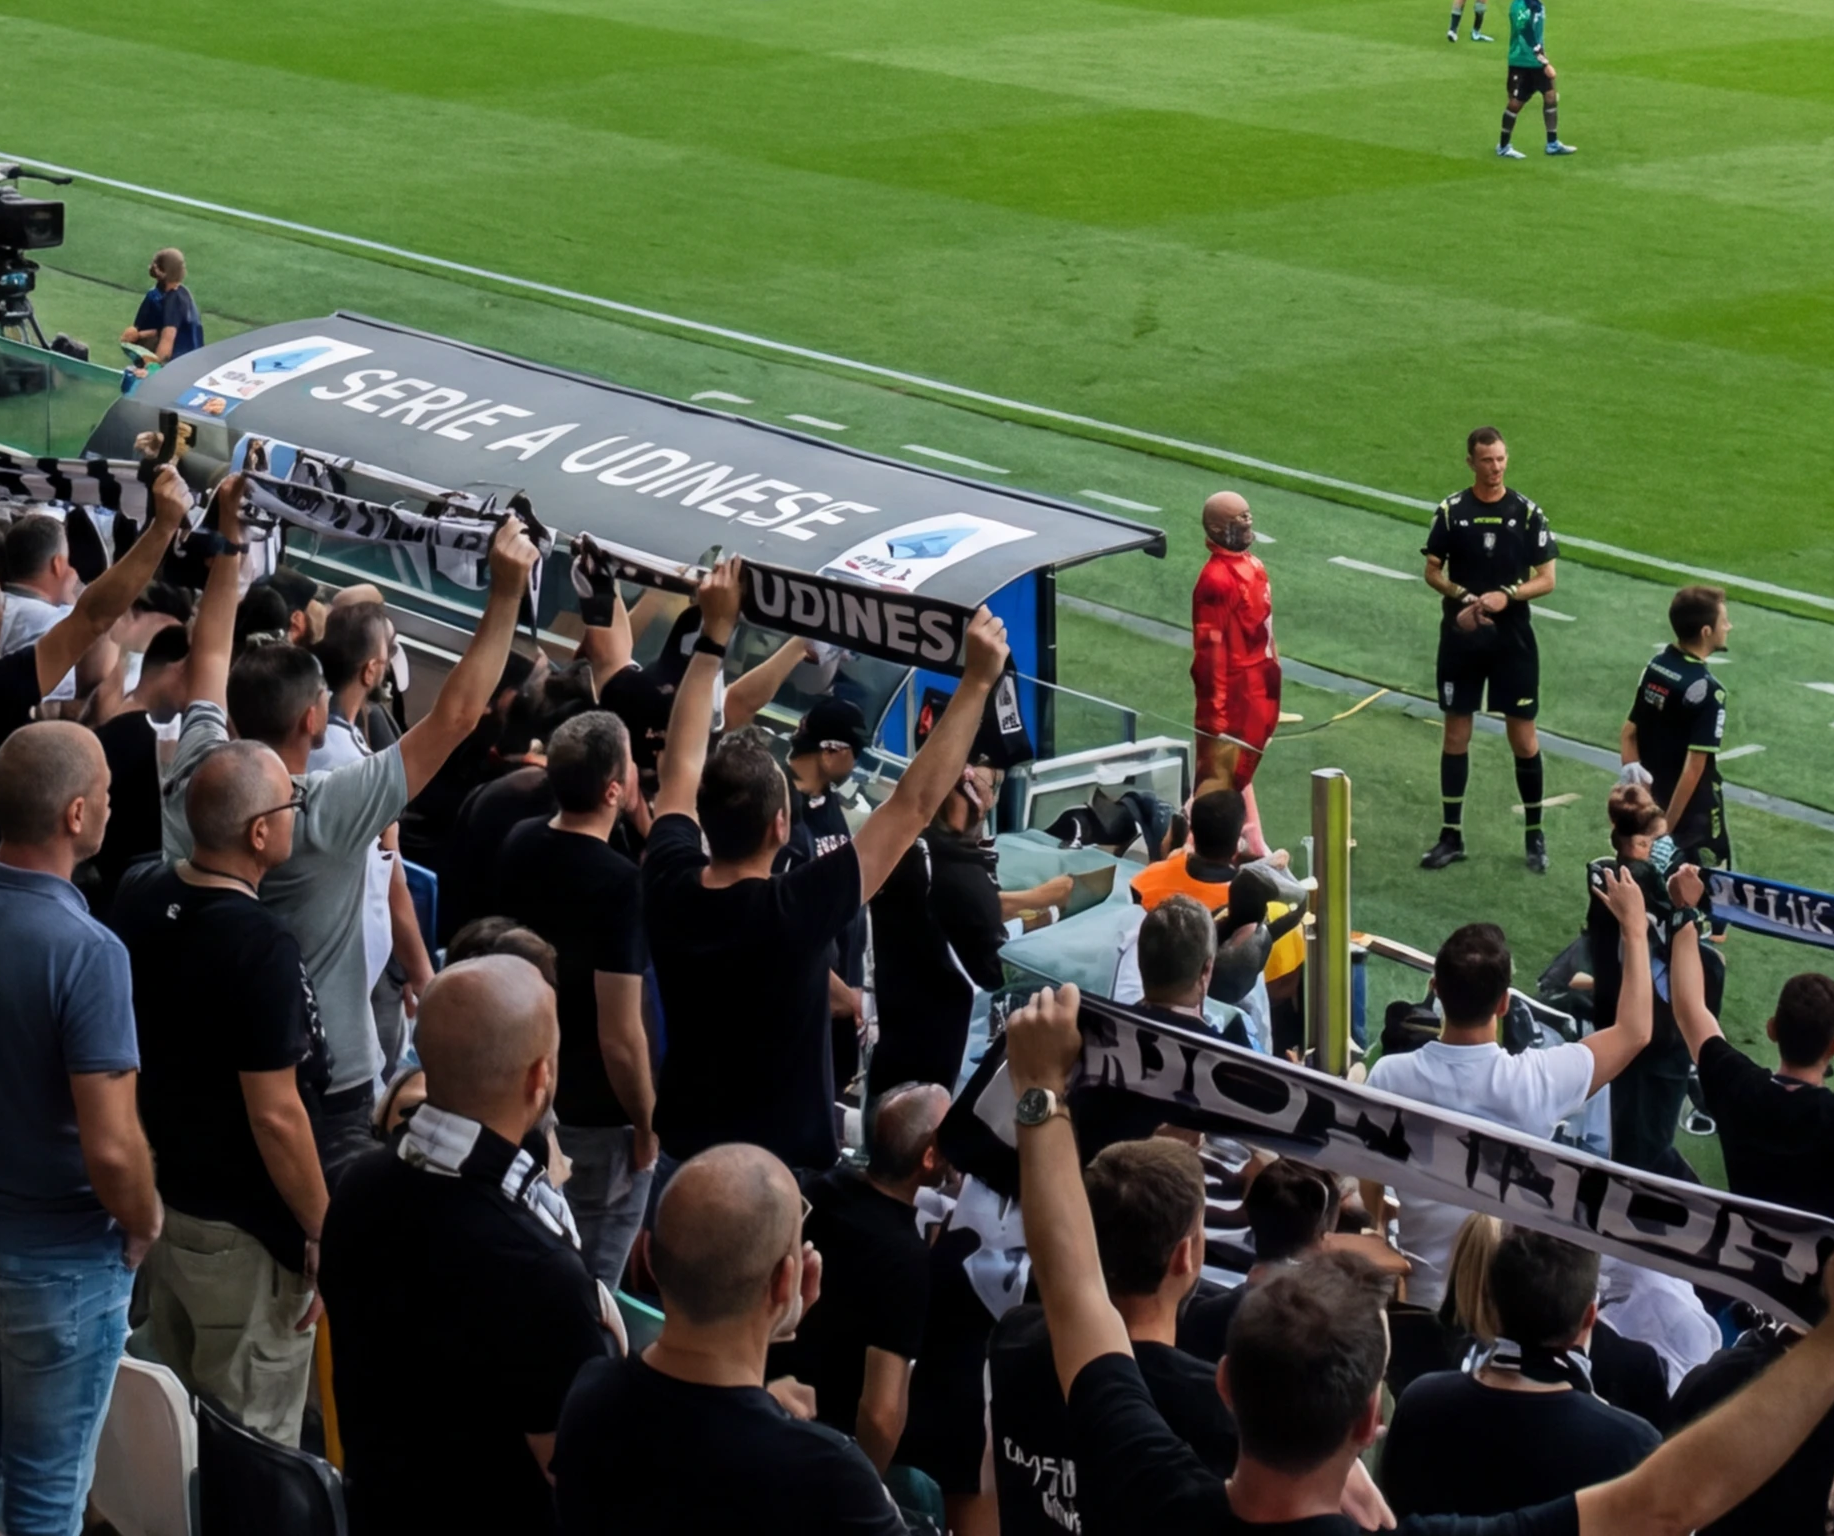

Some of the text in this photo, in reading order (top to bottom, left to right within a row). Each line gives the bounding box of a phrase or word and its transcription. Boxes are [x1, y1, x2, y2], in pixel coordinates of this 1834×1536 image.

[310, 369, 534, 441] SERIE
[485, 422, 581, 461] A
[560, 435, 881, 541] UDINESE
[749, 565, 971, 664] UDINES
